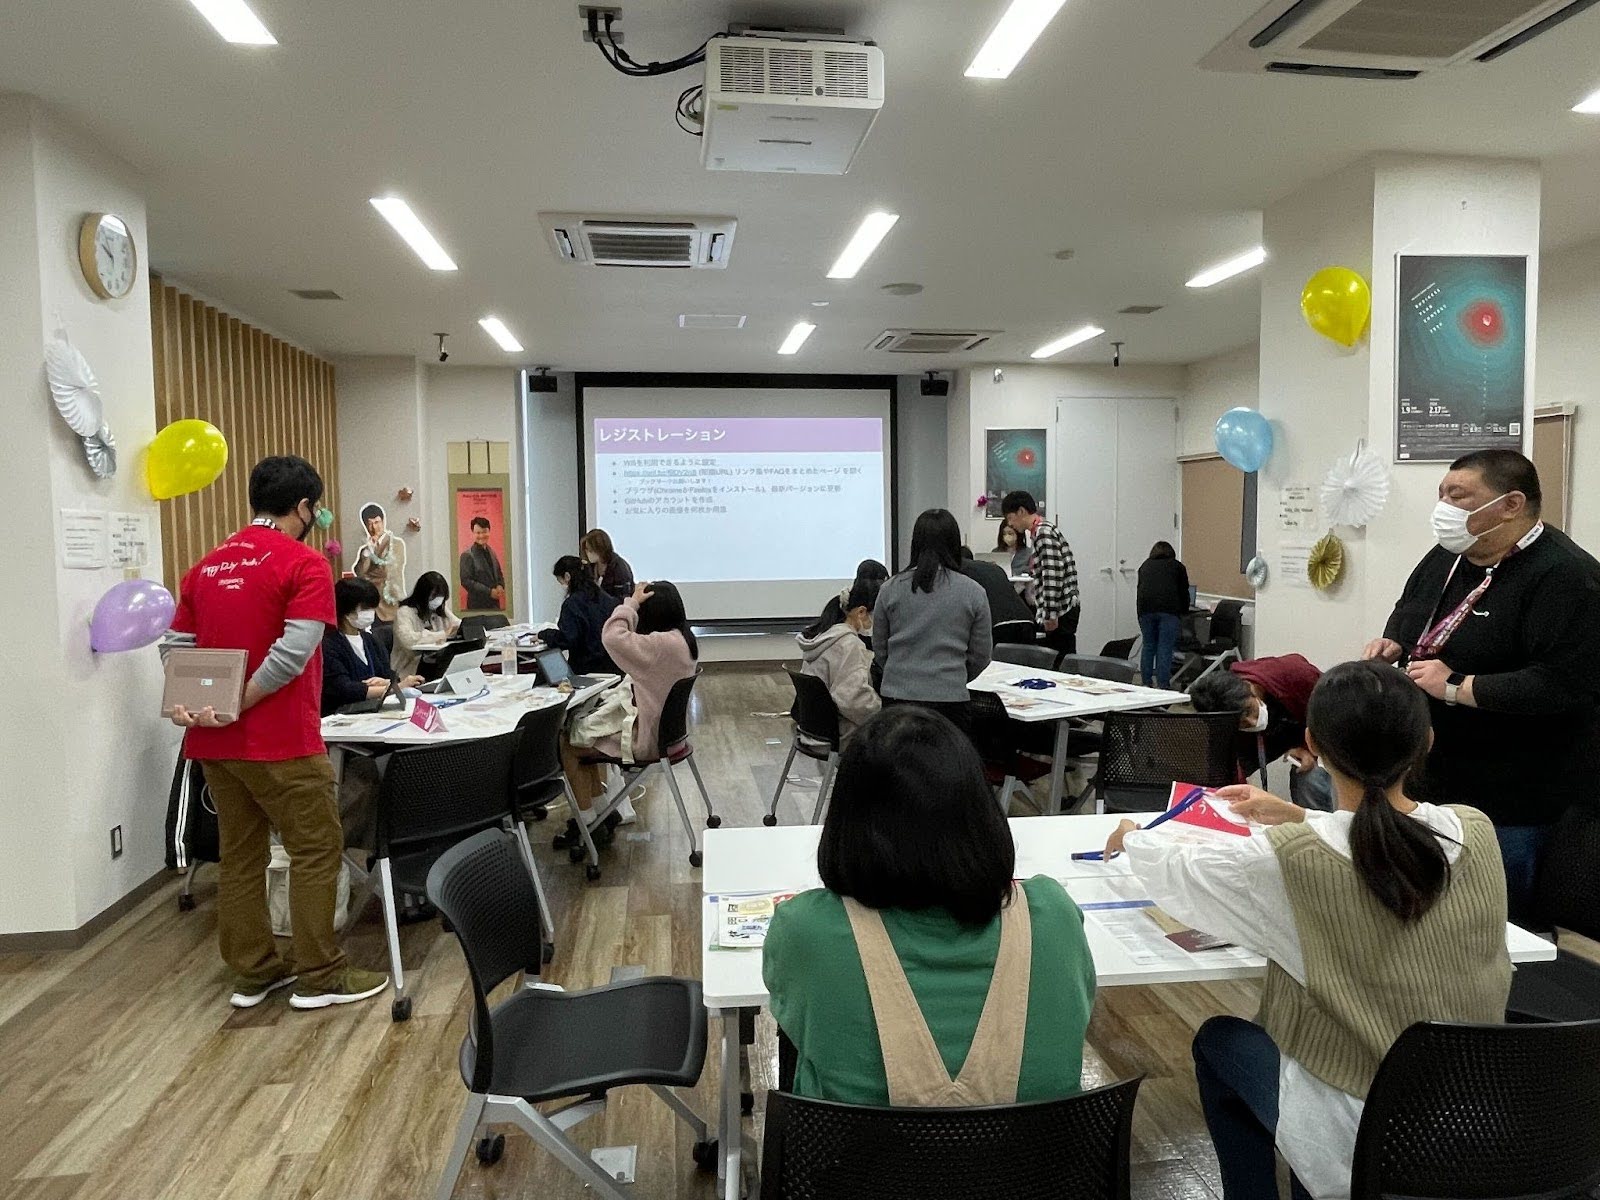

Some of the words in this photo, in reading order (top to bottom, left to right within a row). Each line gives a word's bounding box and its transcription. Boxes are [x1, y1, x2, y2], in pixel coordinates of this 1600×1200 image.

[599, 427, 726, 442] レジストレーション
